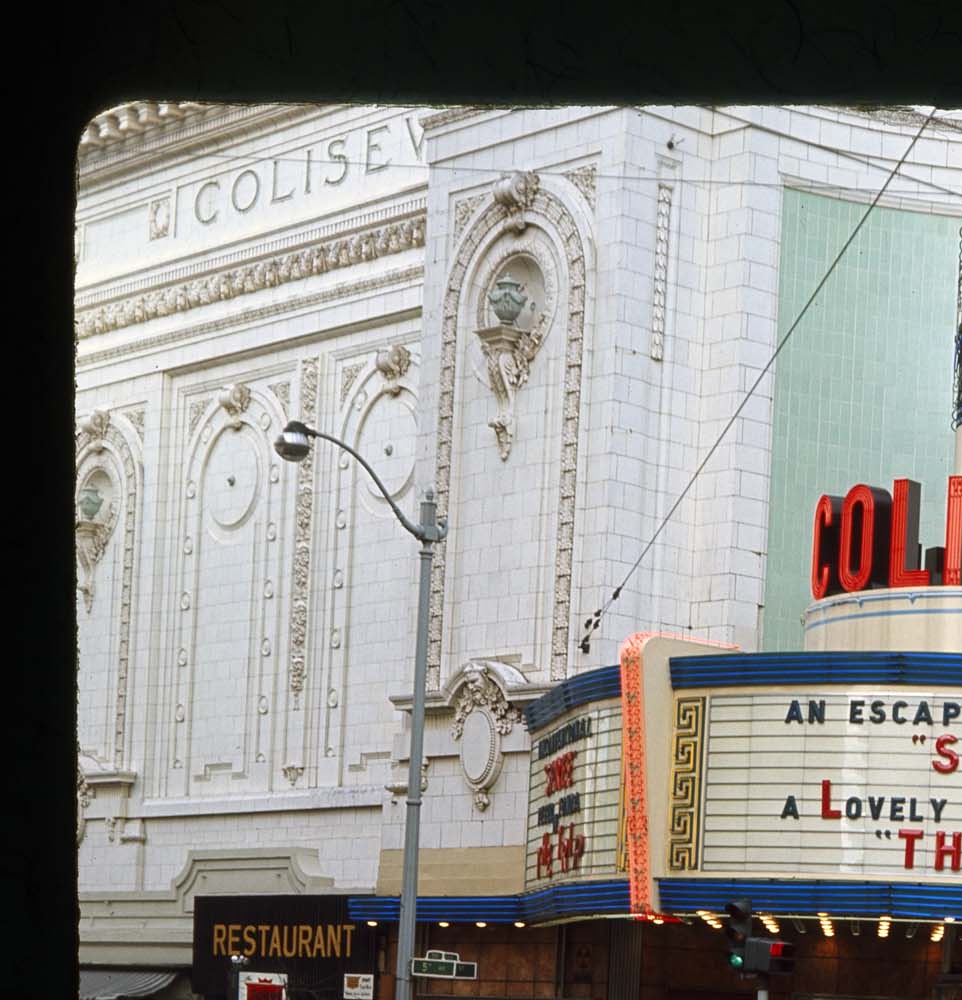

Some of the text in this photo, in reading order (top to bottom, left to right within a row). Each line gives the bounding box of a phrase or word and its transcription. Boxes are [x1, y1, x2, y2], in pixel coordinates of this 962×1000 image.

[784, 700, 826, 724] AN
[780, 795, 800, 820] A
[821, 779, 948, 823] LOVELY
[213, 924, 356, 958] RESTAURANT
